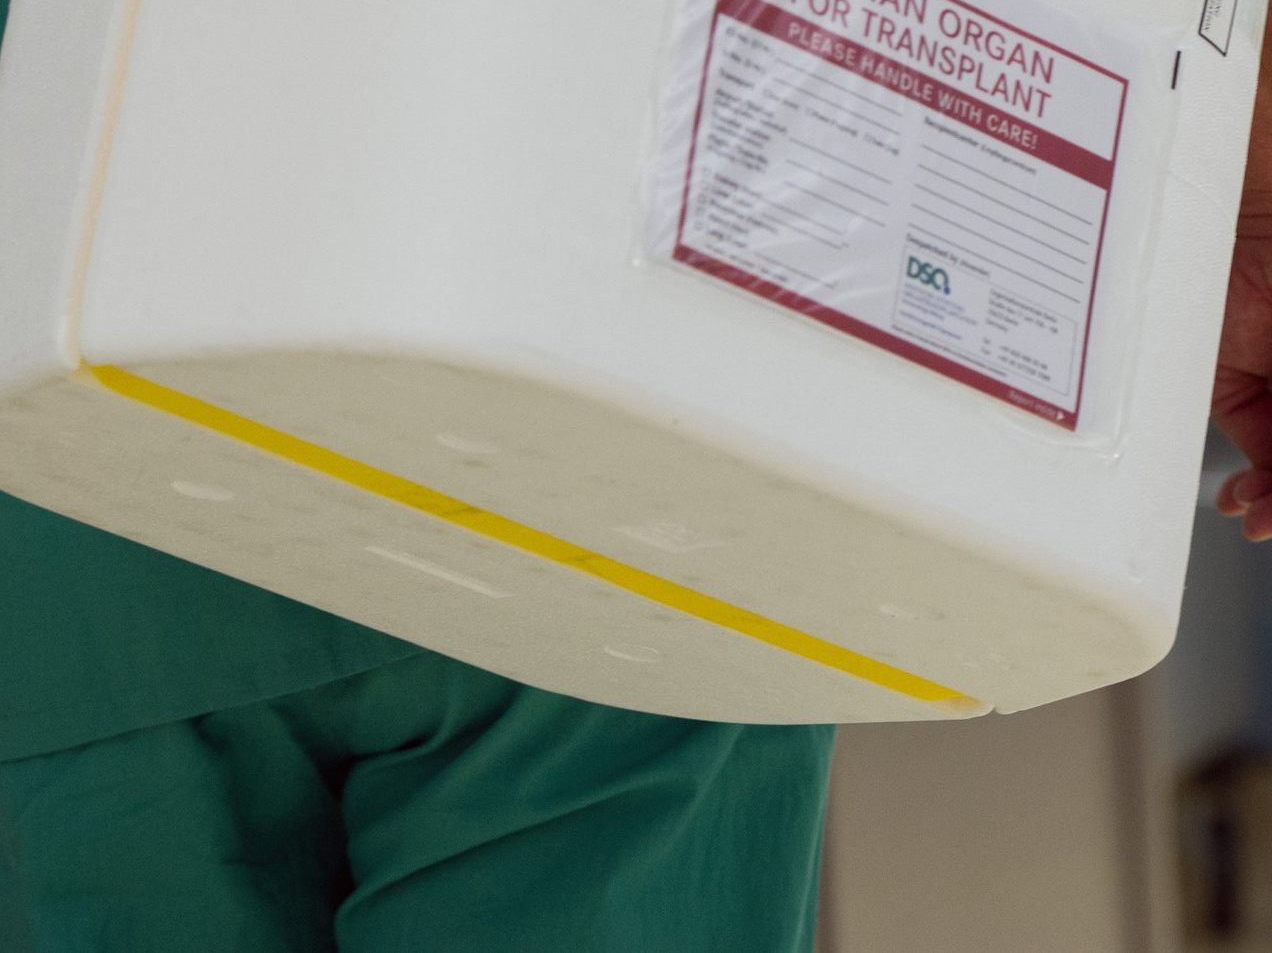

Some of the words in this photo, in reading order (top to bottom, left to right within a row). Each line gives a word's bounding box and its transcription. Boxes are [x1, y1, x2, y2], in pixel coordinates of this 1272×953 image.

[788, 21, 854, 65] PLEASE
[858, 53, 932, 101] HANDLE
[938, 90, 981, 123] WITH
[986, 114, 1037, 147] CARE!
[862, 8, 1051, 118] TRANSPLANT
[938, 8, 1053, 84] ORGAN
